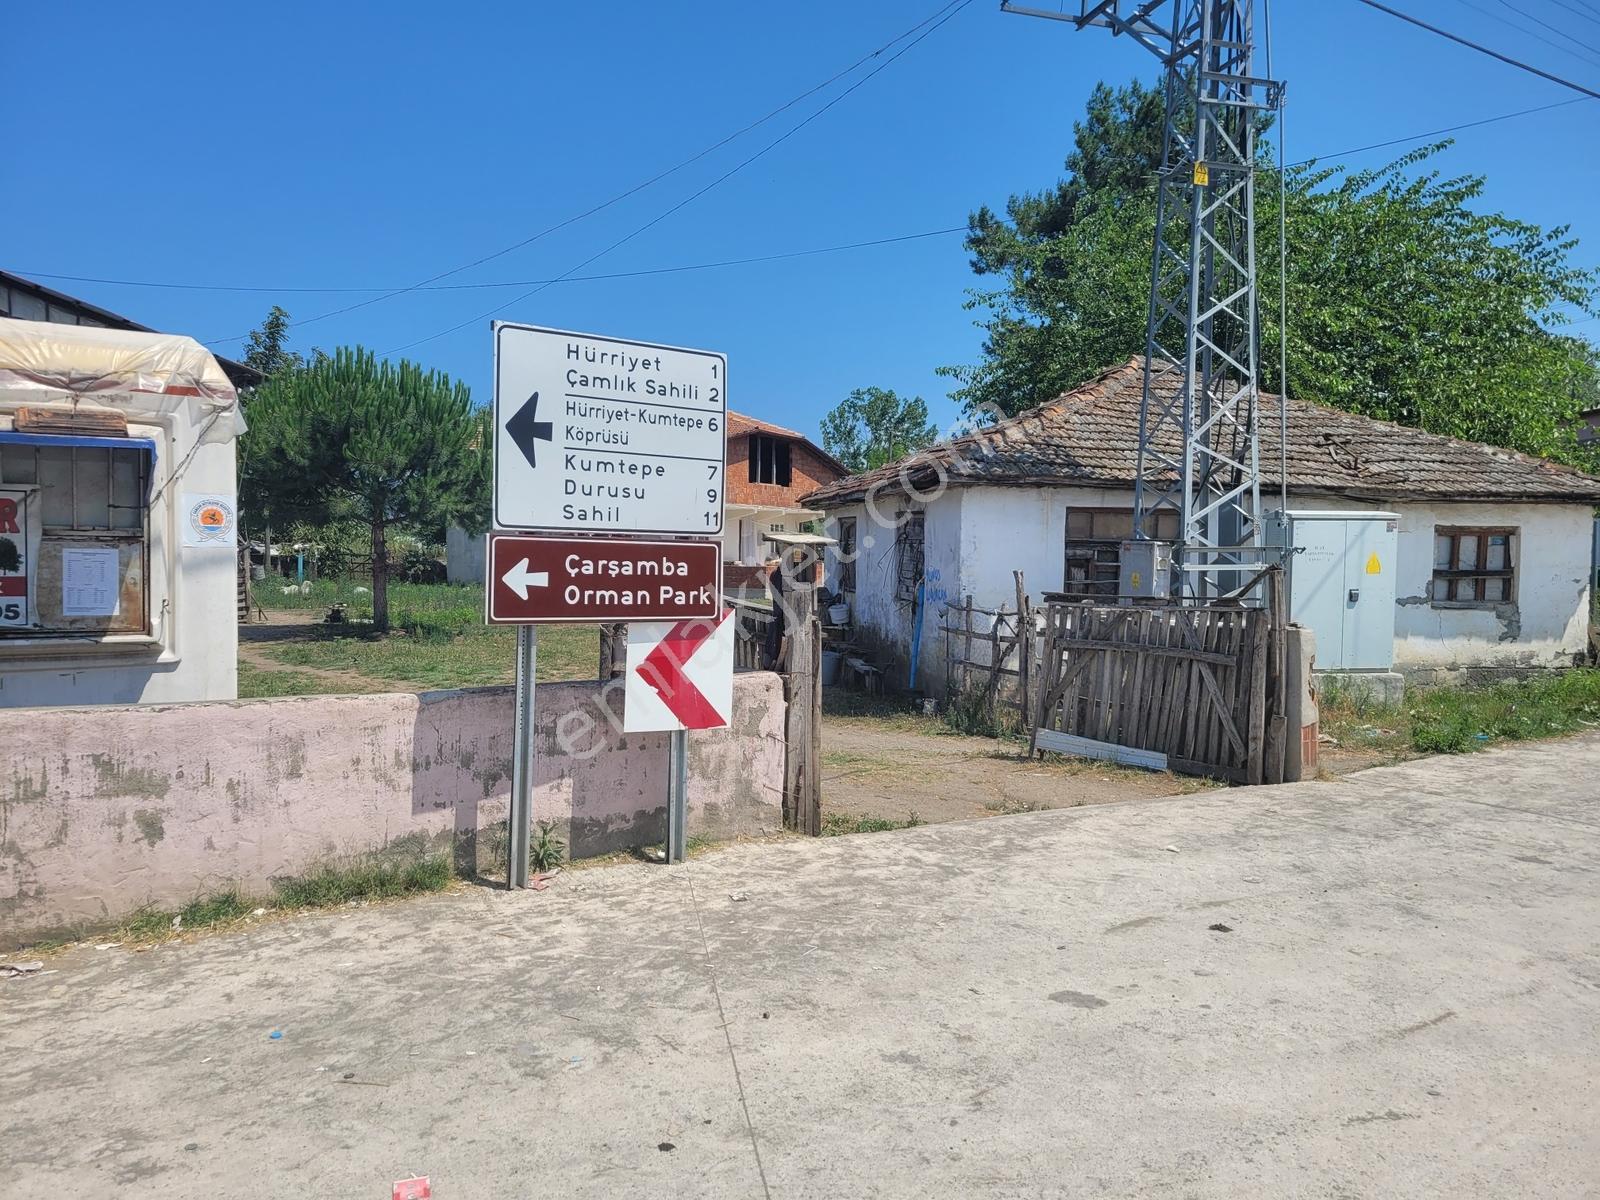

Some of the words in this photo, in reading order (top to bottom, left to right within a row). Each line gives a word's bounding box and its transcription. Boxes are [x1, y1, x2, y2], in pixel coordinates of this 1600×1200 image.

[566, 343, 662, 373] Hürriyet
[711, 364, 718, 379] 1
[566, 369, 637, 393] Çamlık
[645, 379, 699, 401] Sahili
[708, 387, 720, 403] 2
[565, 400, 704, 432] Hürriyet-Kumtepe
[708, 417, 719, 432] 6
[565, 425, 629, 447] Köprüsü
[565, 454, 666, 480] Kumtepe
[707, 465, 719, 481] 7
[564, 478, 646, 500] Durusu
[707, 489, 718, 504] 9
[562, 504, 620, 523] Sahil
[703, 511, 719, 527] 11
[565, 554, 688, 578] Çarşamba
[564, 584, 651, 605] Orman
[659, 585, 711, 605] Park
